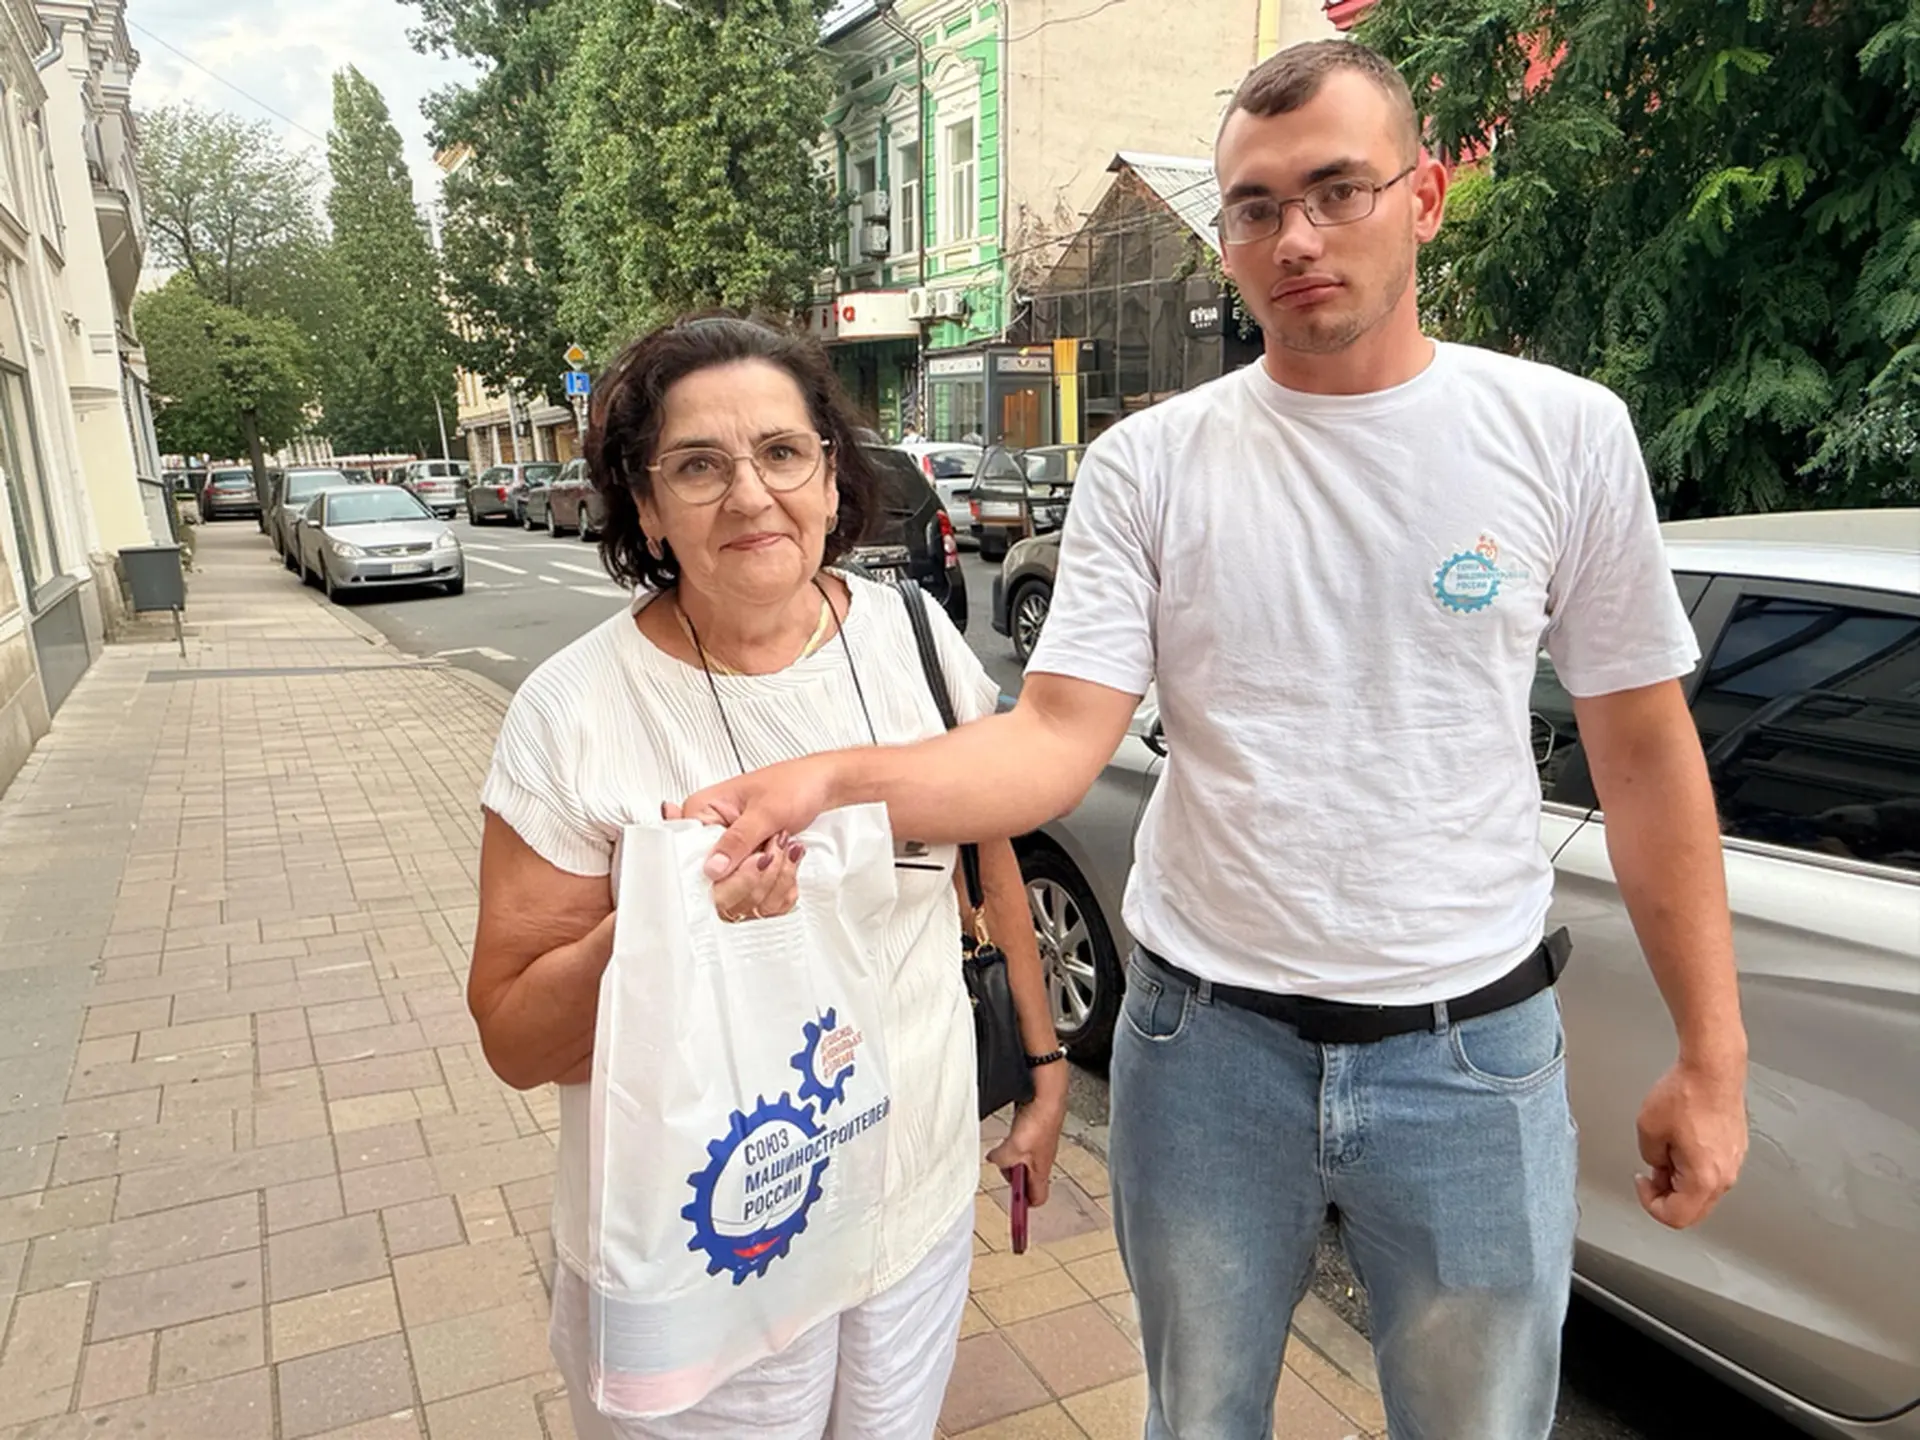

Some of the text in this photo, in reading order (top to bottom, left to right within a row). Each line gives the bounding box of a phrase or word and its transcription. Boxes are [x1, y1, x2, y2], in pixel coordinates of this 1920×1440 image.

[744, 1127, 789, 1166] СОЮЗ
[745, 1095, 890, 1194] МАШИНОСТРОИТЕЛЕЙ
[744, 1173, 802, 1220] РОССИИ
